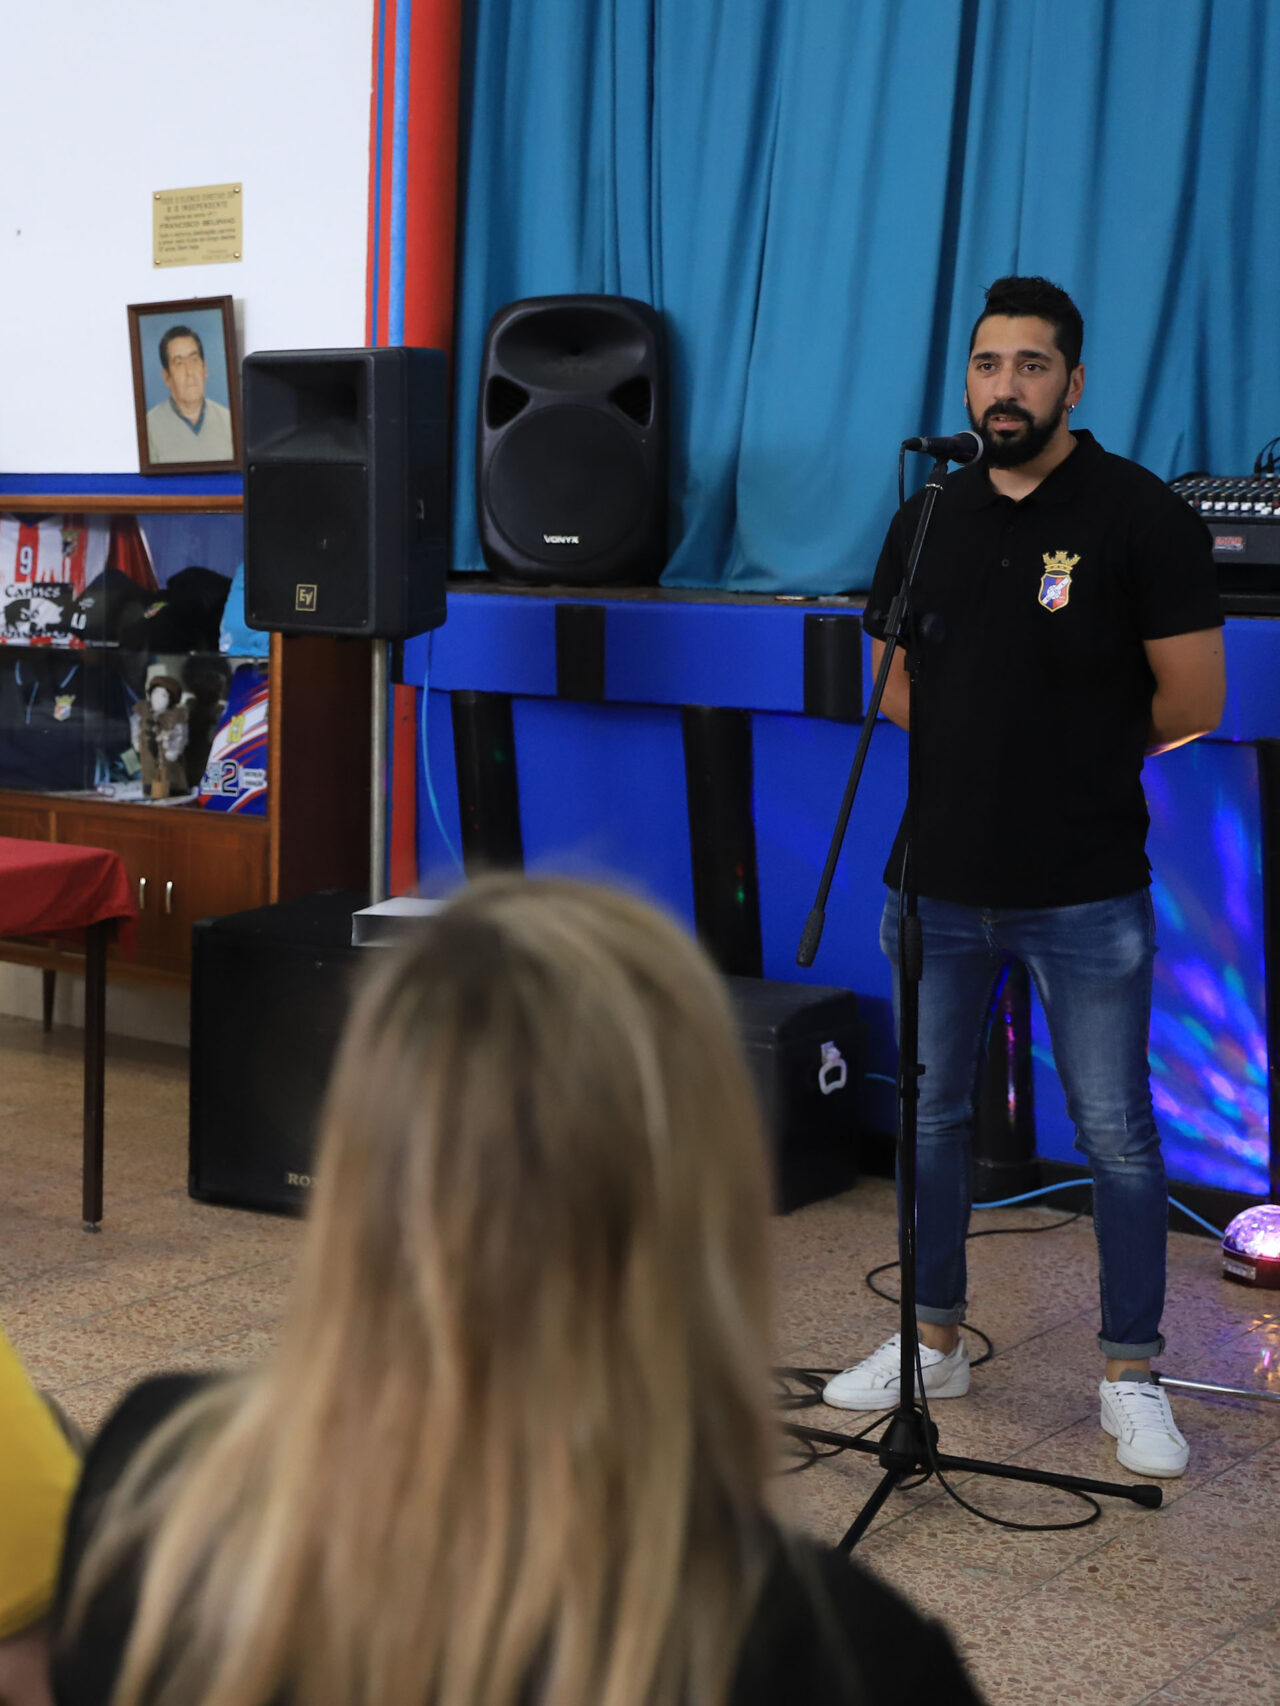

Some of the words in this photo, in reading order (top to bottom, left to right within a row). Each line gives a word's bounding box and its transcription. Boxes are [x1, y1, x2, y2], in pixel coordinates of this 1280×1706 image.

[543, 534, 580, 545] VONYX
[19, 546, 34, 576] 9
[5, 584, 61, 599] Carnes
